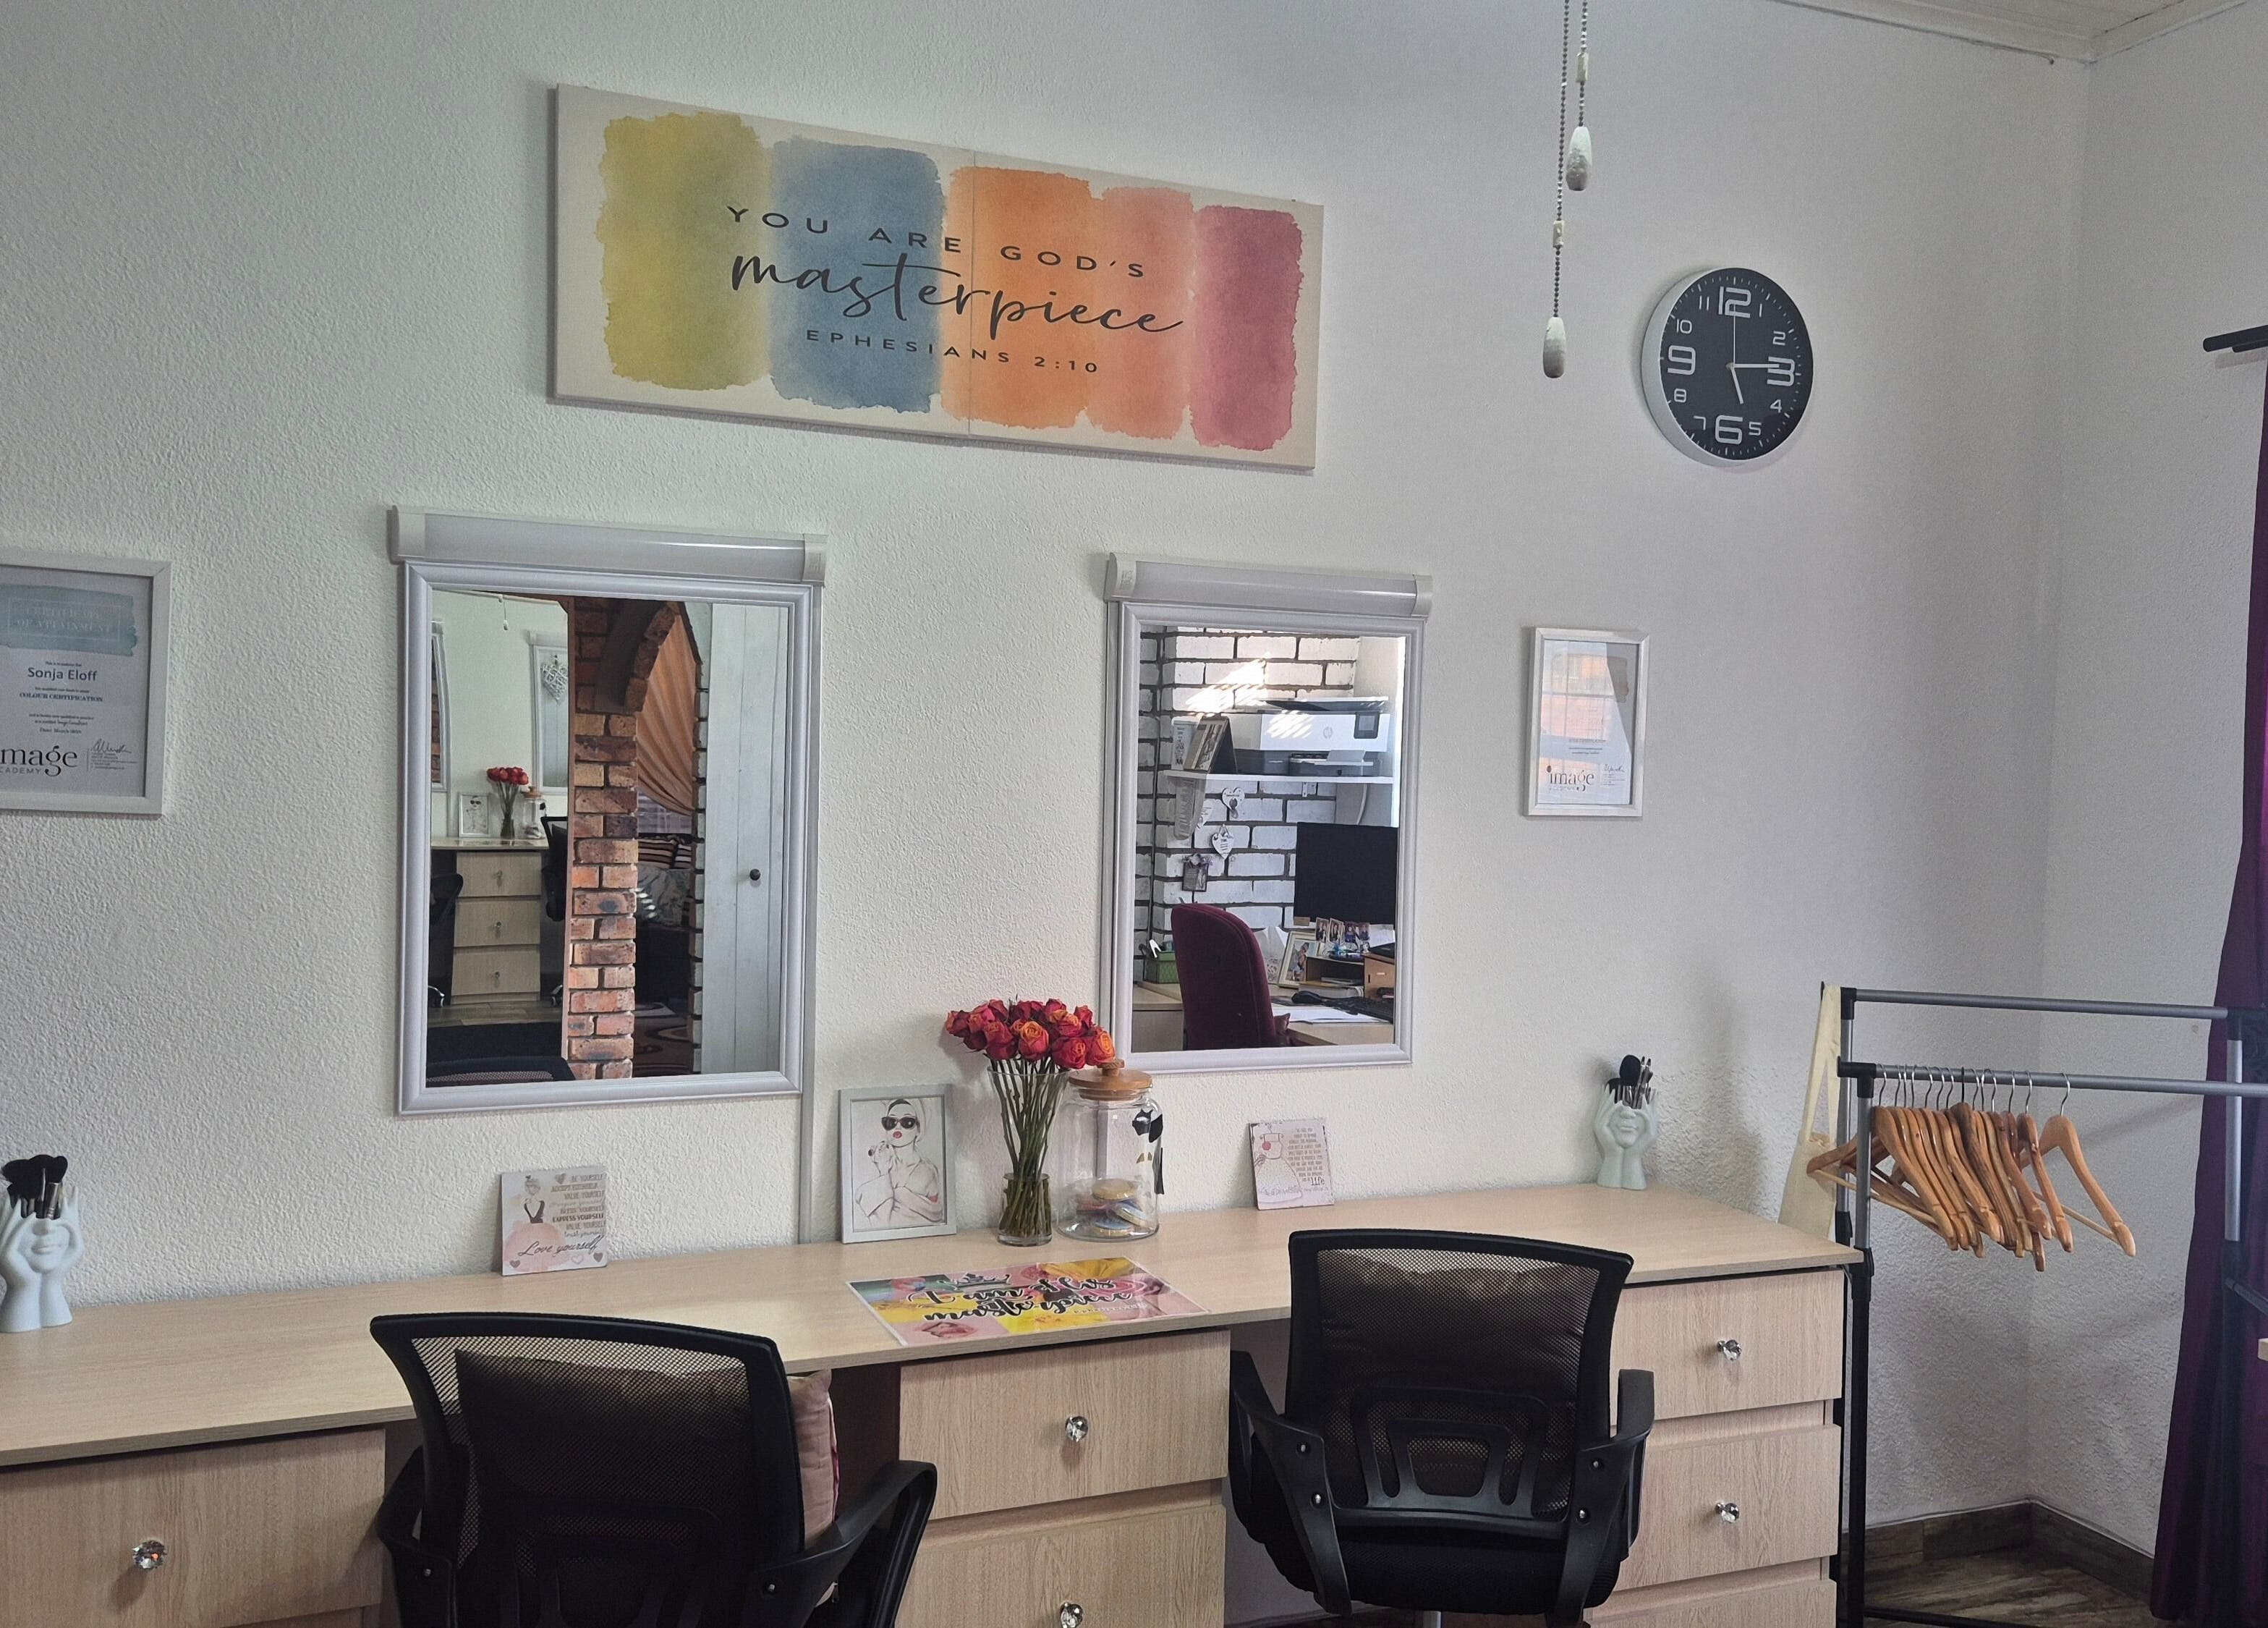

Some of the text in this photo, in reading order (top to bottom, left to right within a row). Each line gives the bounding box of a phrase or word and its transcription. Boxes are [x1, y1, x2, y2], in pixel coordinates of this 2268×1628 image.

[726, 205, 1144, 278] YOU ARE GOD'S
[731, 253, 1184, 341] masterpiece
[1718, 286, 1752, 318] 12
[1675, 318, 1693, 335] 10
[1772, 330, 1786, 346] 2
[806, 329, 1098, 373] EPHESIANS 2:10
[1667, 344, 1696, 376] 9
[1767, 356, 1796, 386] 3
[1673, 388, 1687, 403] 8
[1770, 399, 1783, 413] 4
[1693, 415, 1707, 431] 7
[1715, 415, 1743, 444] 6
[1748, 421, 1762, 436] 5
[27, 666, 98, 681] Sonja Eloff
[1546, 765, 1594, 792] image
[518, 1234, 604, 1258] Love yourself
[925, 1292, 1131, 1320] masterpiece
[963, 1290, 1023, 1300] am
